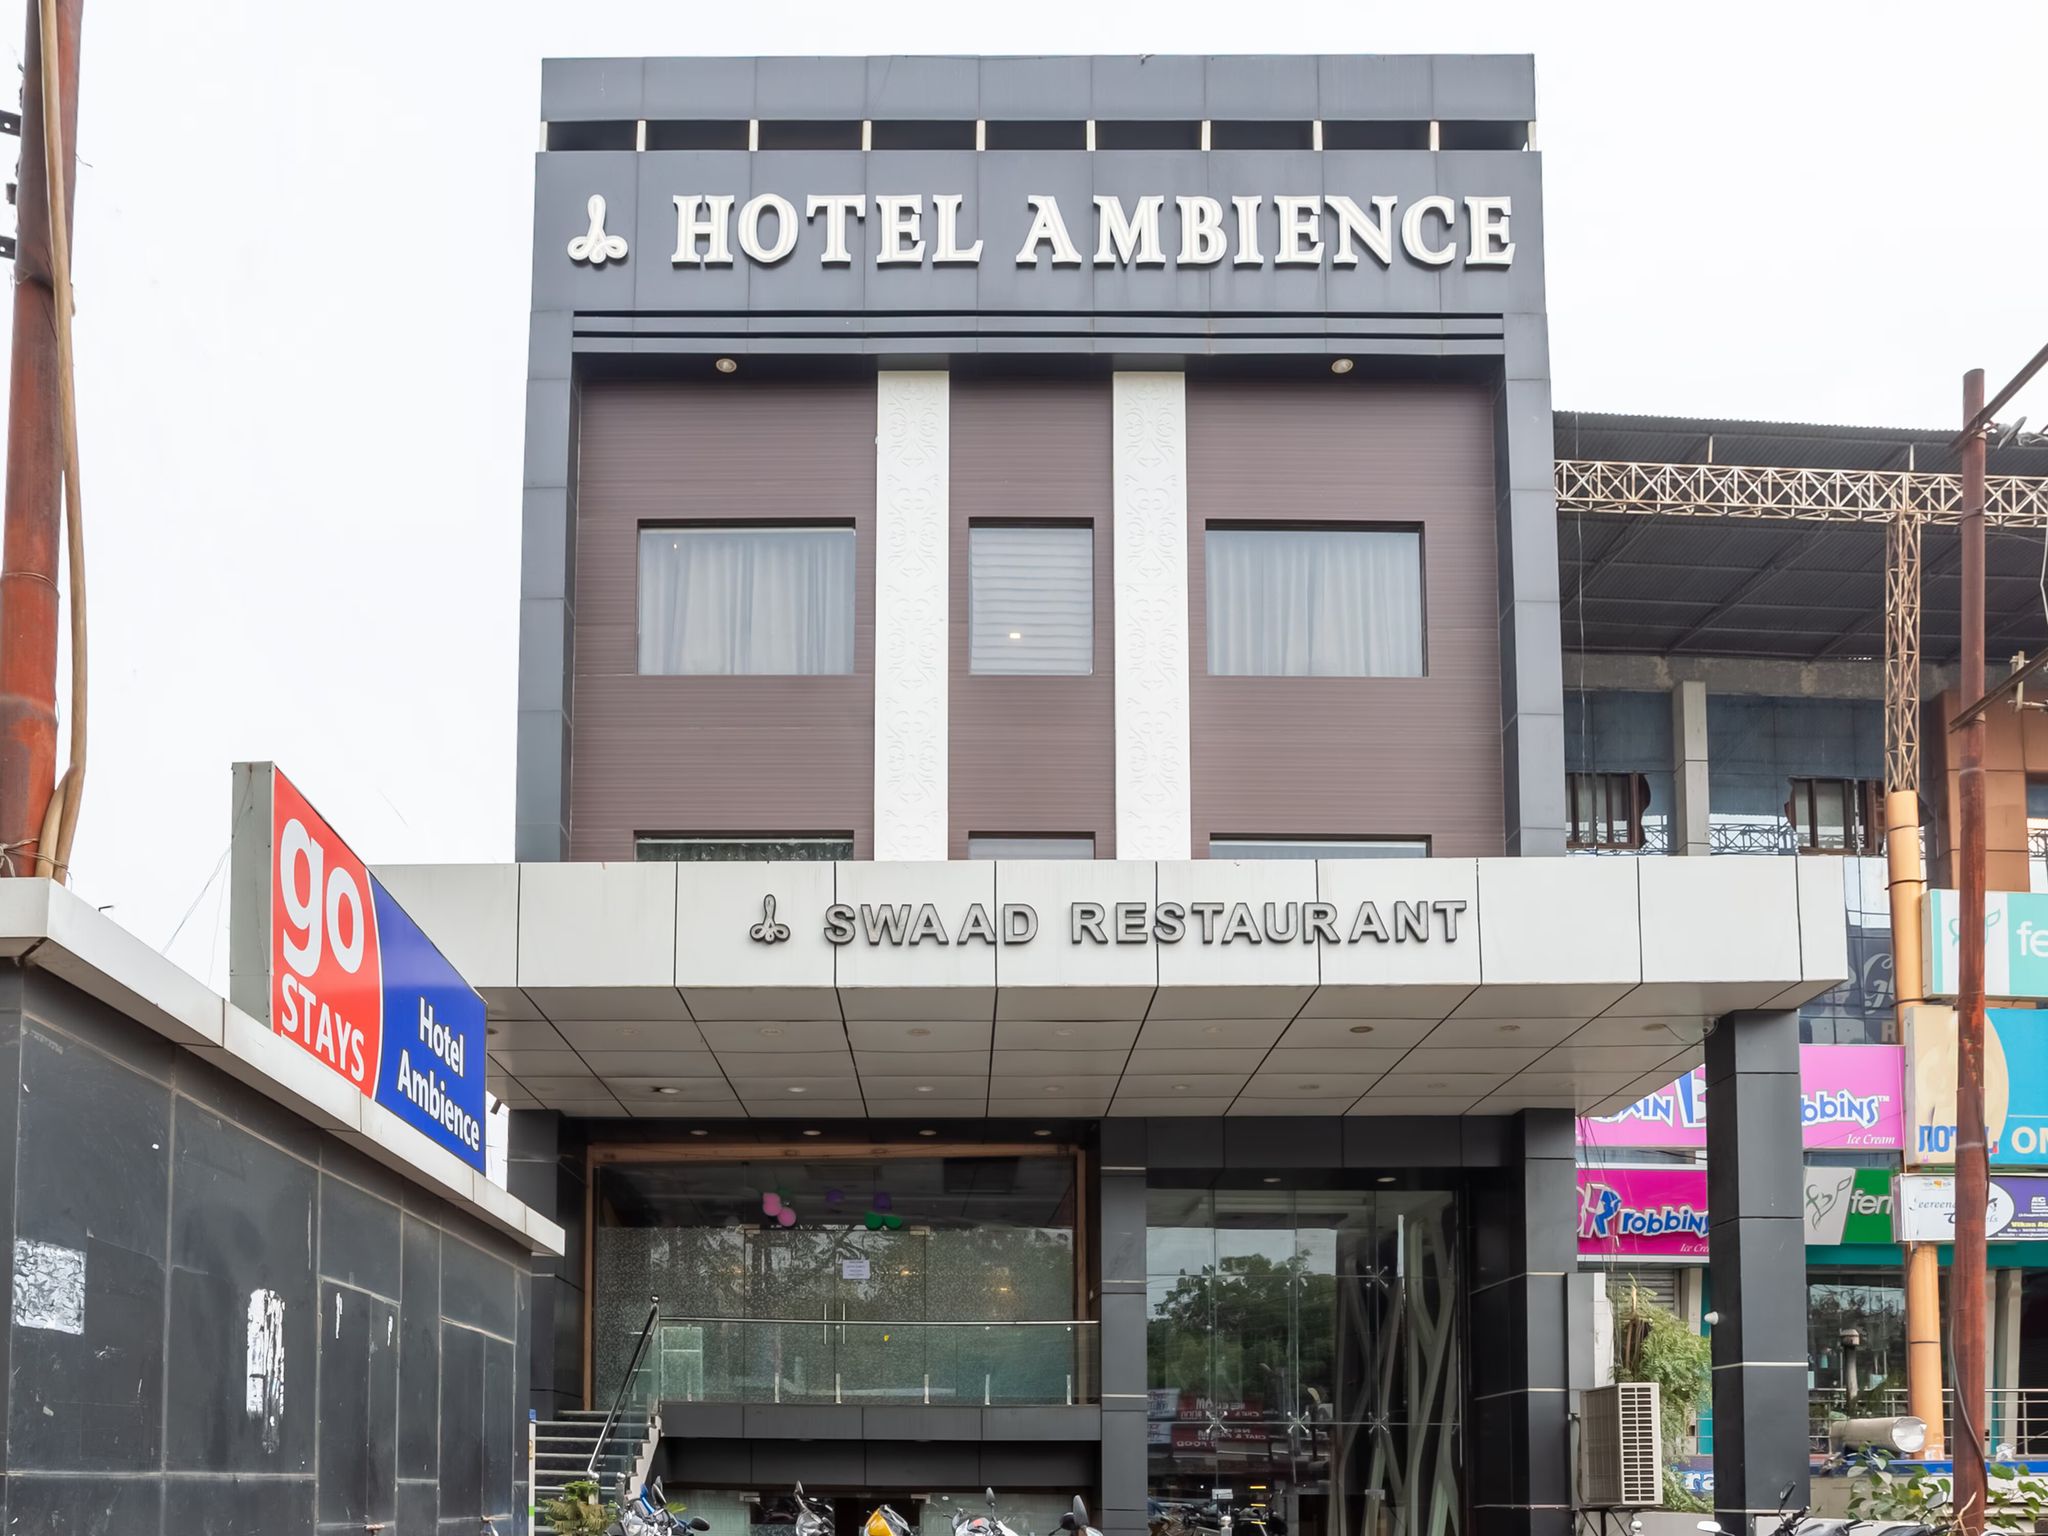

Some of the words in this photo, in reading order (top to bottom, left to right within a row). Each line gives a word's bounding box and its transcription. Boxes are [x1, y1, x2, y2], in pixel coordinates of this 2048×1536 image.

[671, 193, 984, 267] HOTEL
[1016, 195, 1516, 269] AMBIENCE
[280, 818, 364, 978] go
[824, 903, 1039, 945] SWAAD
[1071, 900, 1467, 944] RESTAURANT
[281, 973, 365, 1083] STAYS
[419, 996, 465, 1078] Hotel
[397, 1049, 481, 1153] Ambience
[1846, 1133, 1861, 1145] Ice
[1863, 1133, 1896, 1145] Cream
